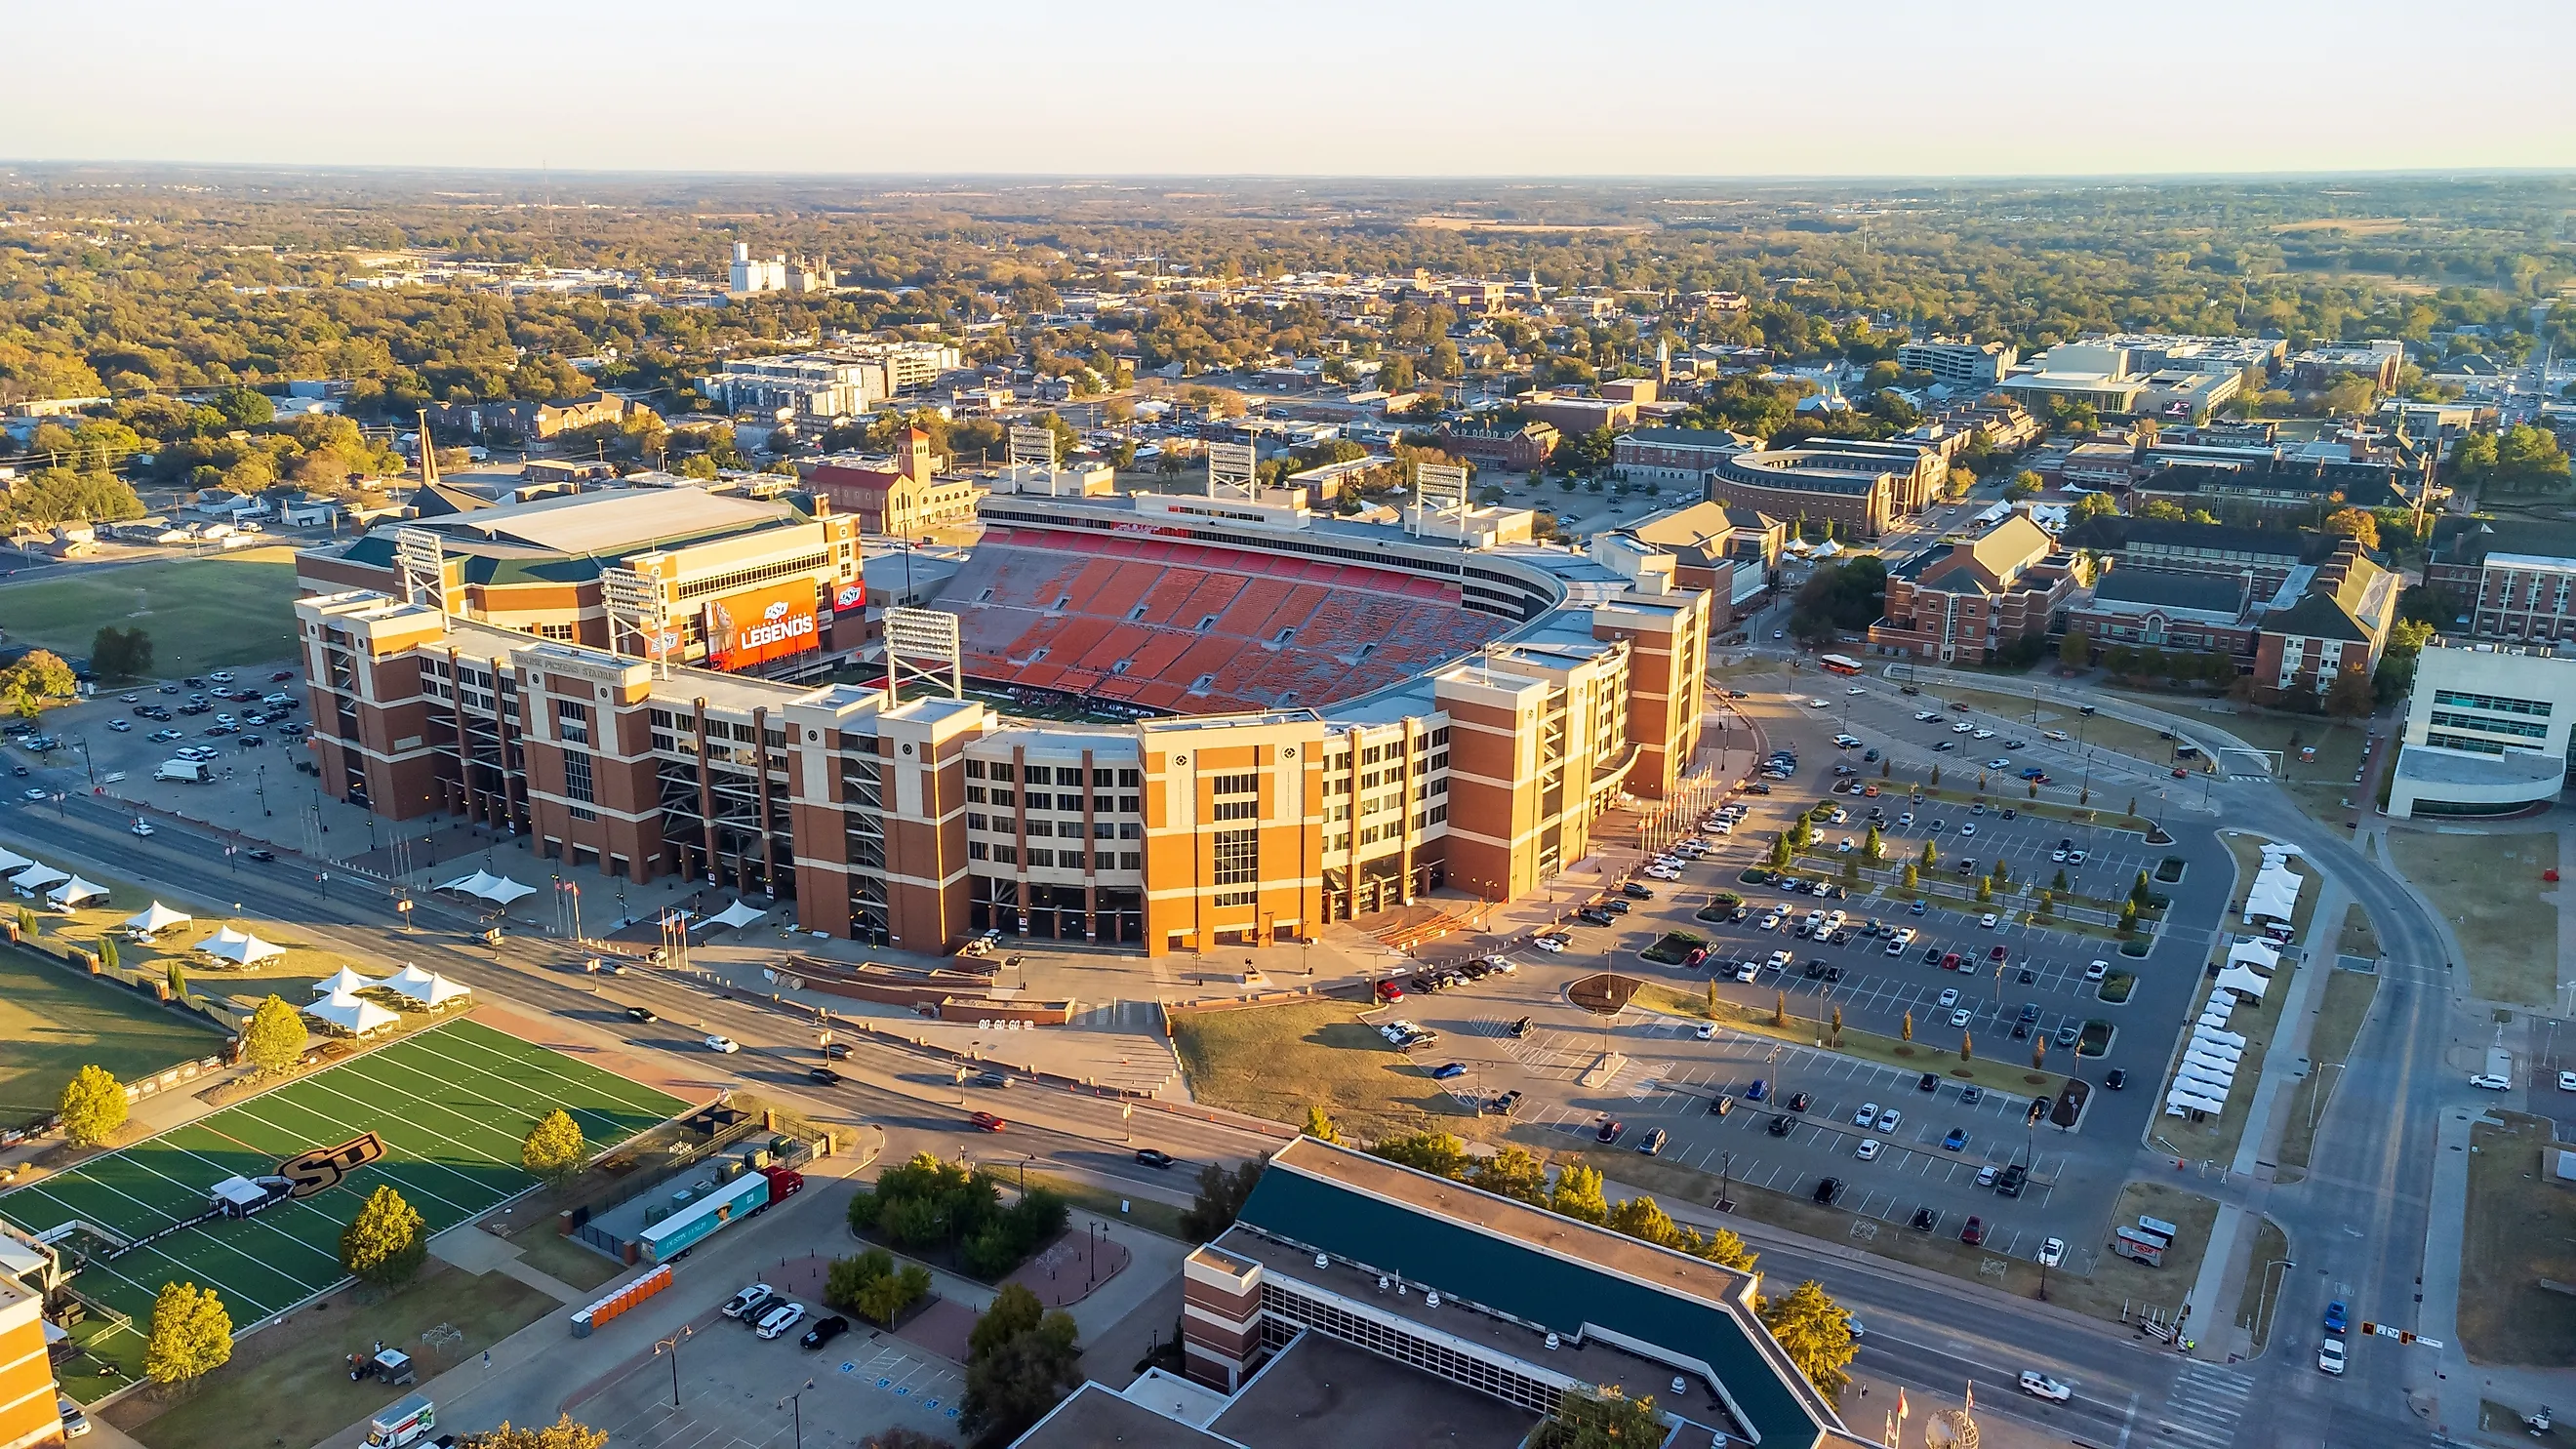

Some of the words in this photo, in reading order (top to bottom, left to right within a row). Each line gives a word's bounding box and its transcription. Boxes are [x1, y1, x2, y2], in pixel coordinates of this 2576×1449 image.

[741, 616, 814, 651] LEGENDS
[515, 655, 543, 667] BOONE
[545, 661, 579, 673] PICKENS
[583, 667, 618, 681] STADIUM
[979, 1019, 990, 1029] GO
[994, 1020, 1005, 1029] GO
[1008, 1020, 1020, 1029] GO
